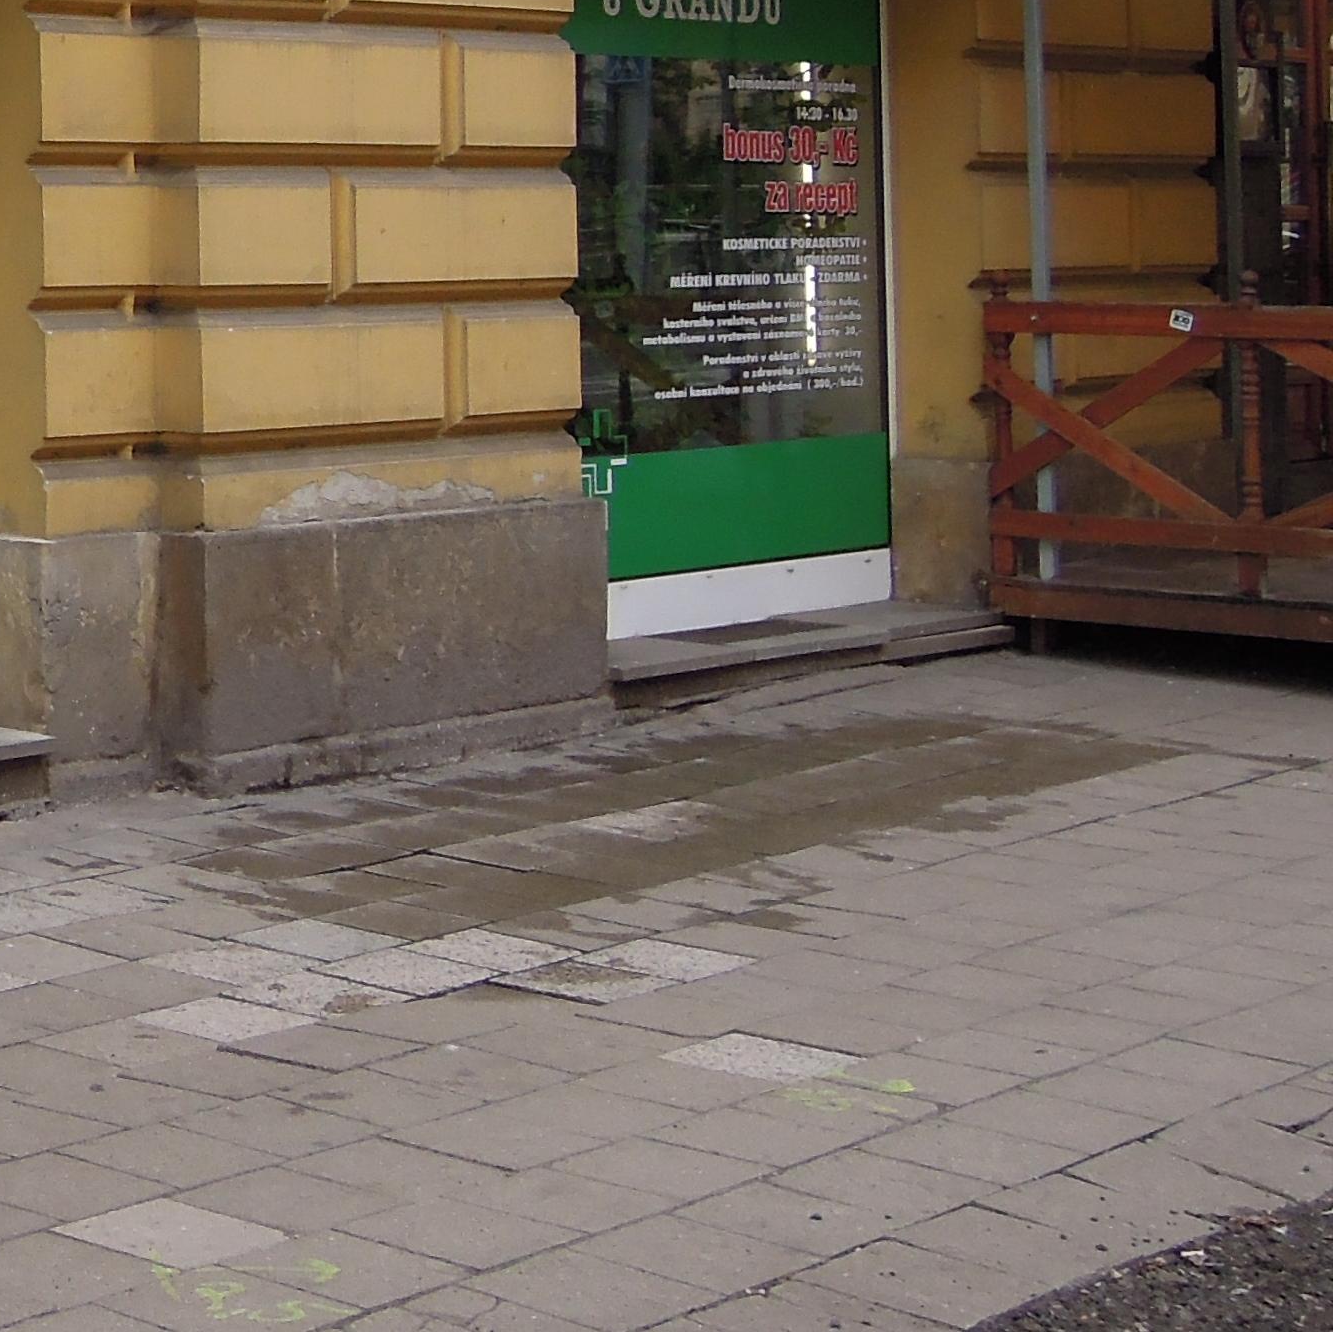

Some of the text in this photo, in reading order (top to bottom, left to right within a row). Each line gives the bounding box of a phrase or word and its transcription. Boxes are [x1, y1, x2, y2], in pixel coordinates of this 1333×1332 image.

[723, 122, 785, 163] bonus
[832, 126, 859, 166] Kč
[764, 178, 858, 218] za recept
[715, 270, 771, 287] KREVNÍHO
[818, 270, 861, 284] ZDARMA
